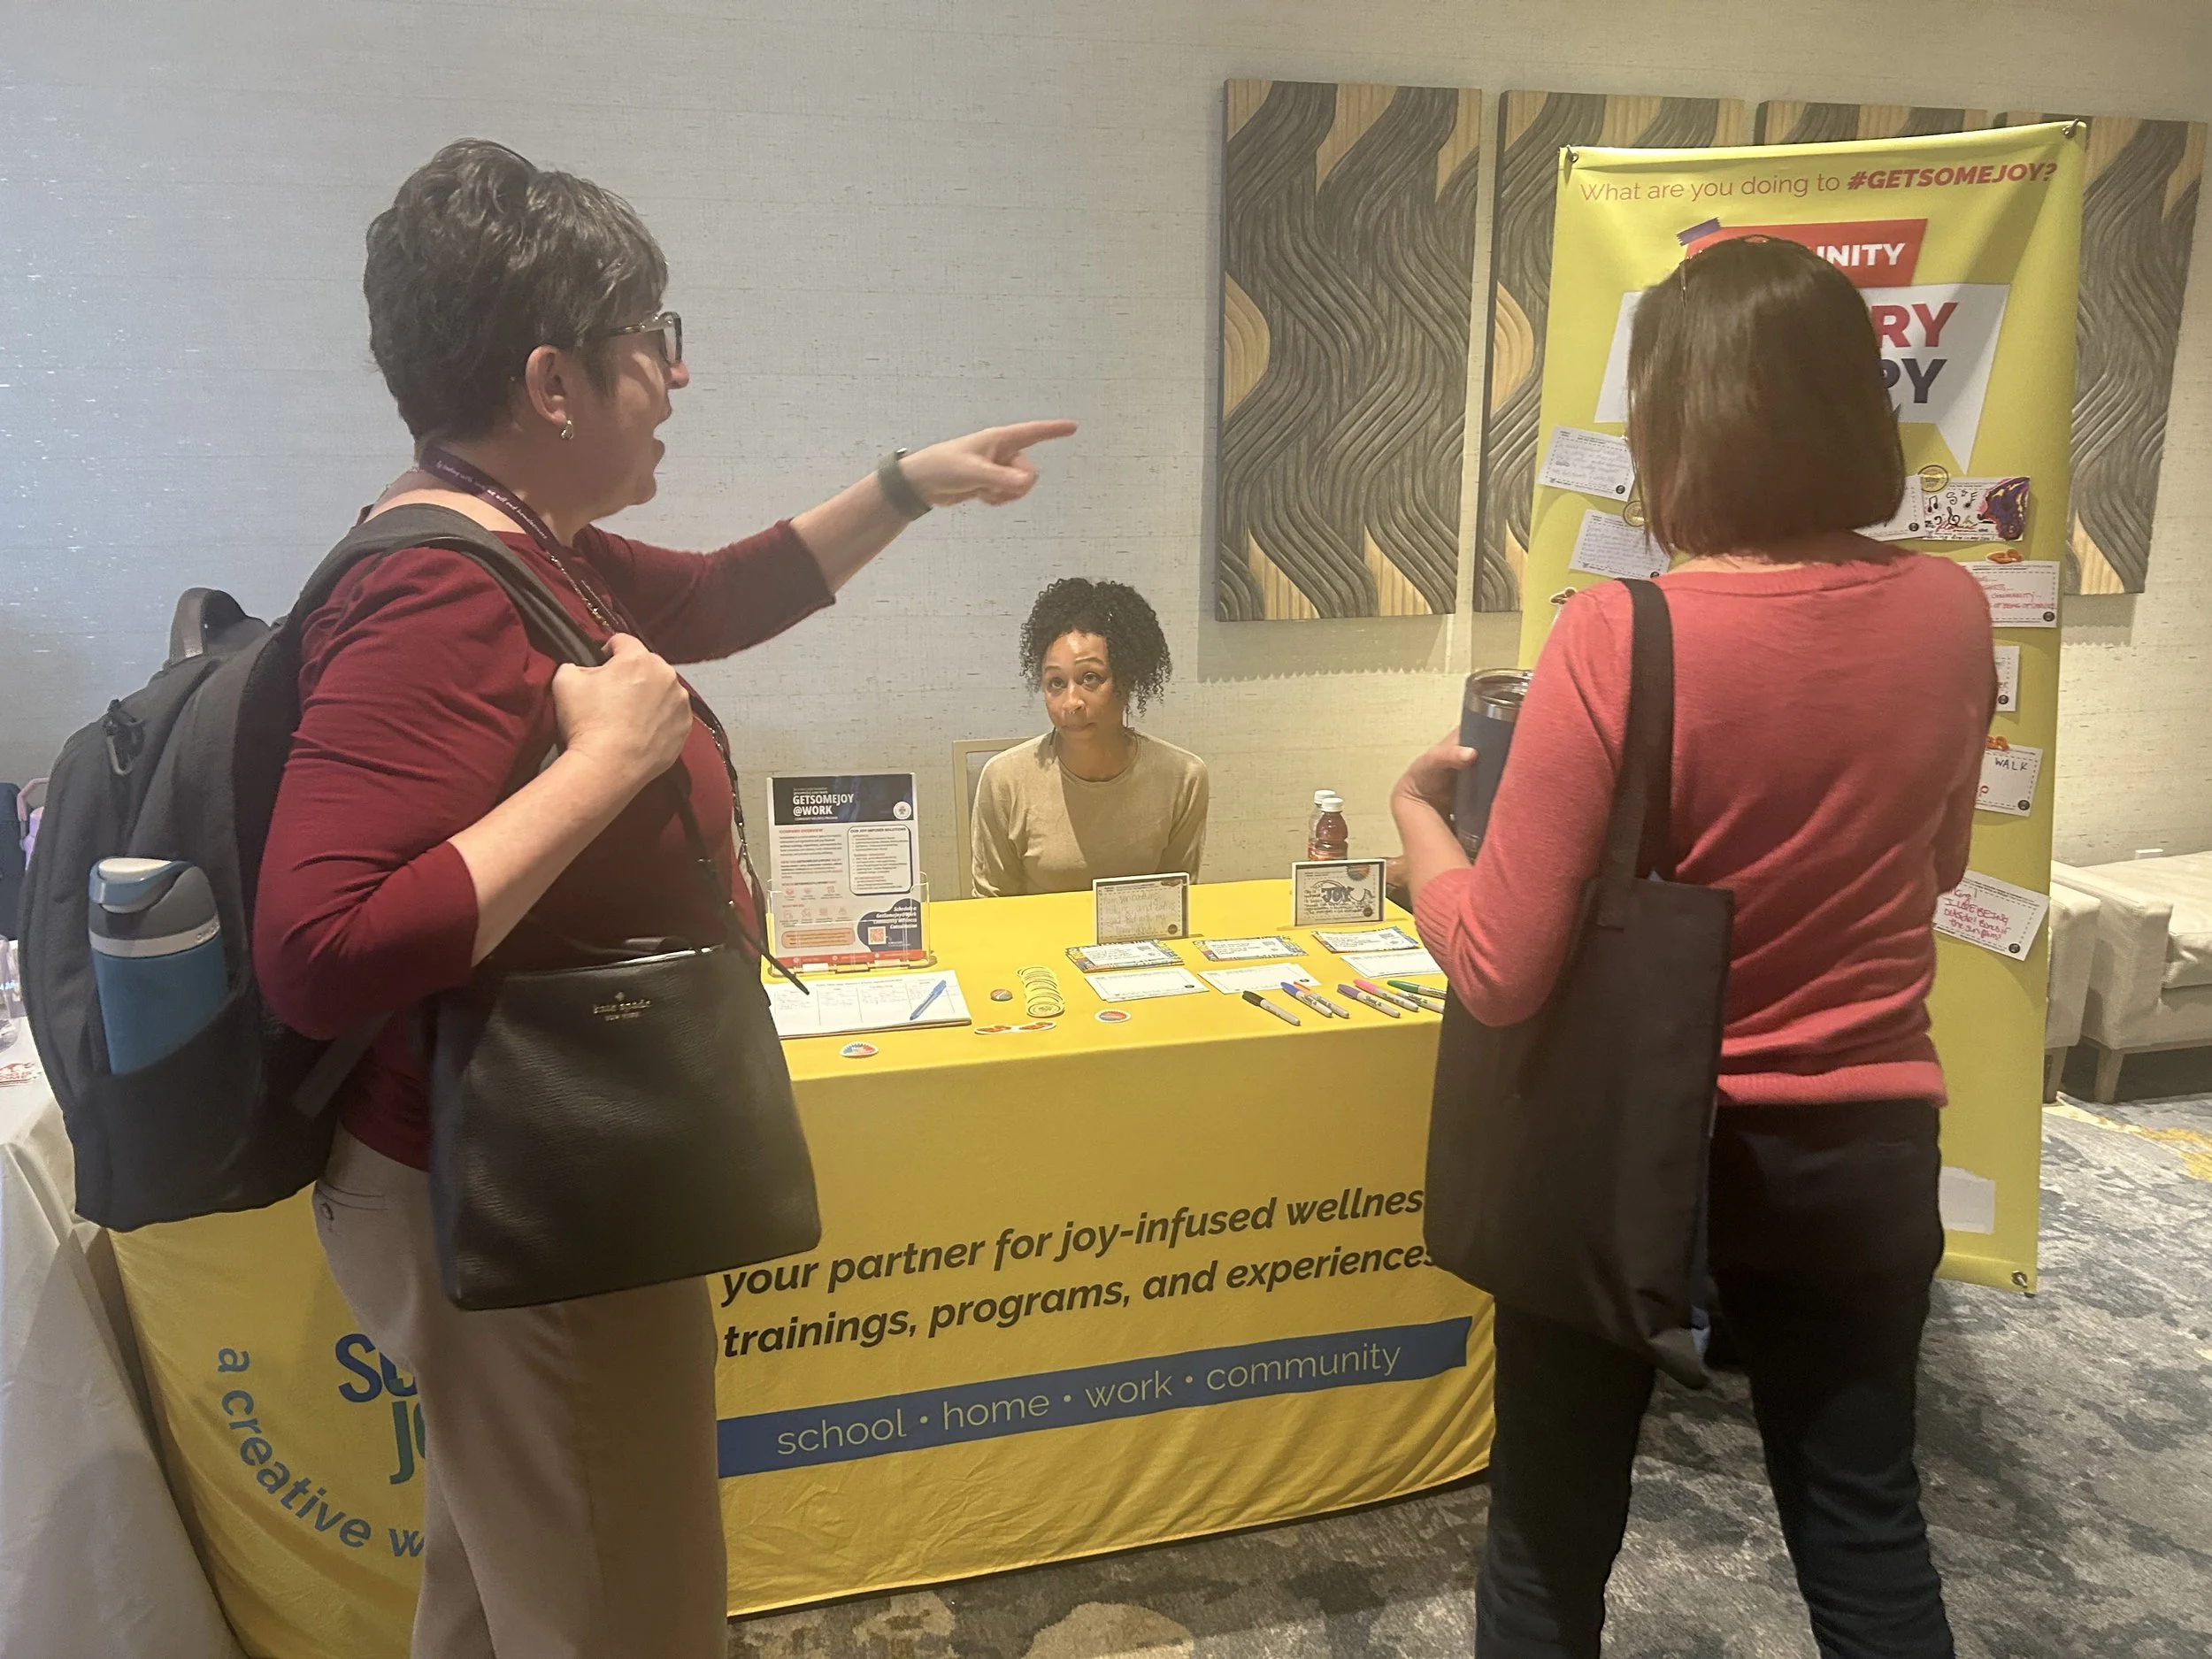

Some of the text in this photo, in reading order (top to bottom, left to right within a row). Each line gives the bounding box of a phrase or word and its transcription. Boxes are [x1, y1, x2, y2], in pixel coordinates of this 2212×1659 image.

[1580, 162, 2058, 201] What are you doing to #GETSOMEJOY?
[1994, 757, 2029, 772] WALK
[793, 793, 854, 806] GETSOMEJOY
[793, 805, 833, 817] @WORK
[721, 1263, 819, 1308] your
[827, 1240, 985, 1293] partner
[993, 1229, 1052, 1271] for
[1053, 1197, 1277, 1262] joy-infused
[724, 1310, 917, 1357] trainings,
[928, 1280, 1130, 1338] programs,
[1143, 1261, 1217, 1300] and
[218, 1348, 250, 1372] a
[777, 1343, 1402, 1456] school home work community
[222, 1389, 372, 1548] creative
